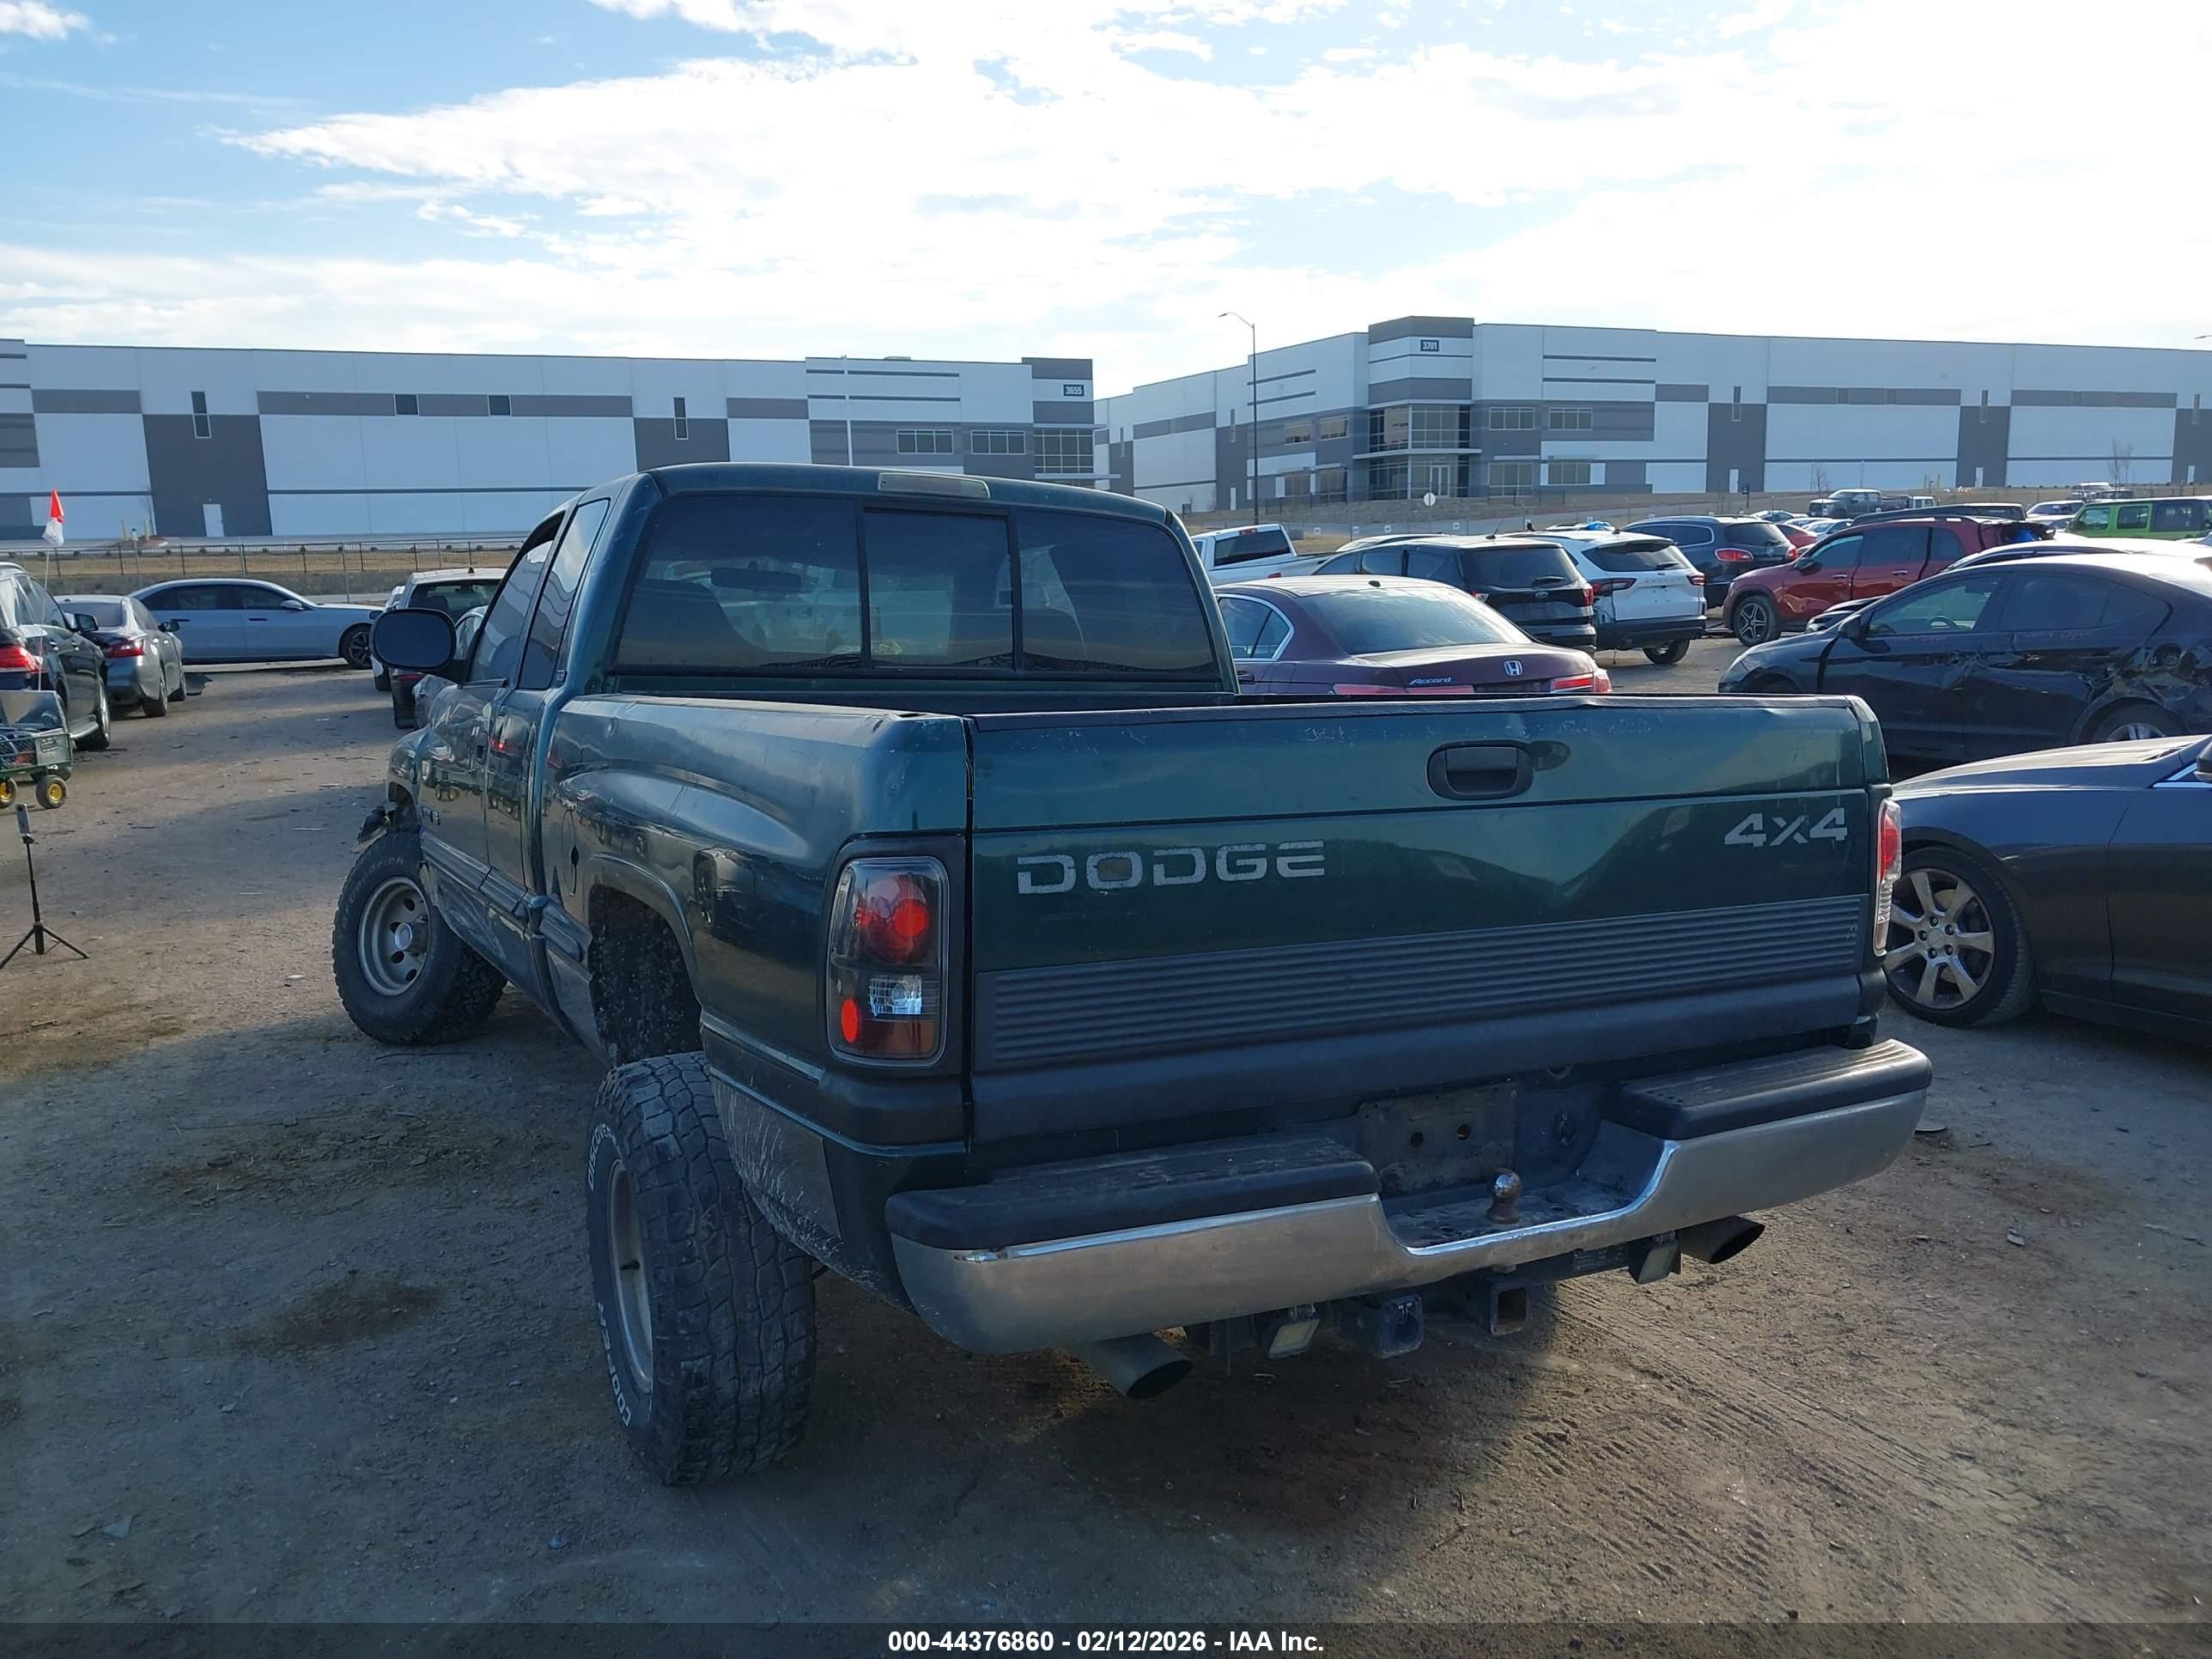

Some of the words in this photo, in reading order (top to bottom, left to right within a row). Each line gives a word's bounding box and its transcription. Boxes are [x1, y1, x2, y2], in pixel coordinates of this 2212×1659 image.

[1421, 341, 1437, 351] 3701
[1408, 677, 1452, 685] Accord
[1018, 840, 1326, 895] DODGE
[598, 1302, 632, 1427] COOPER
